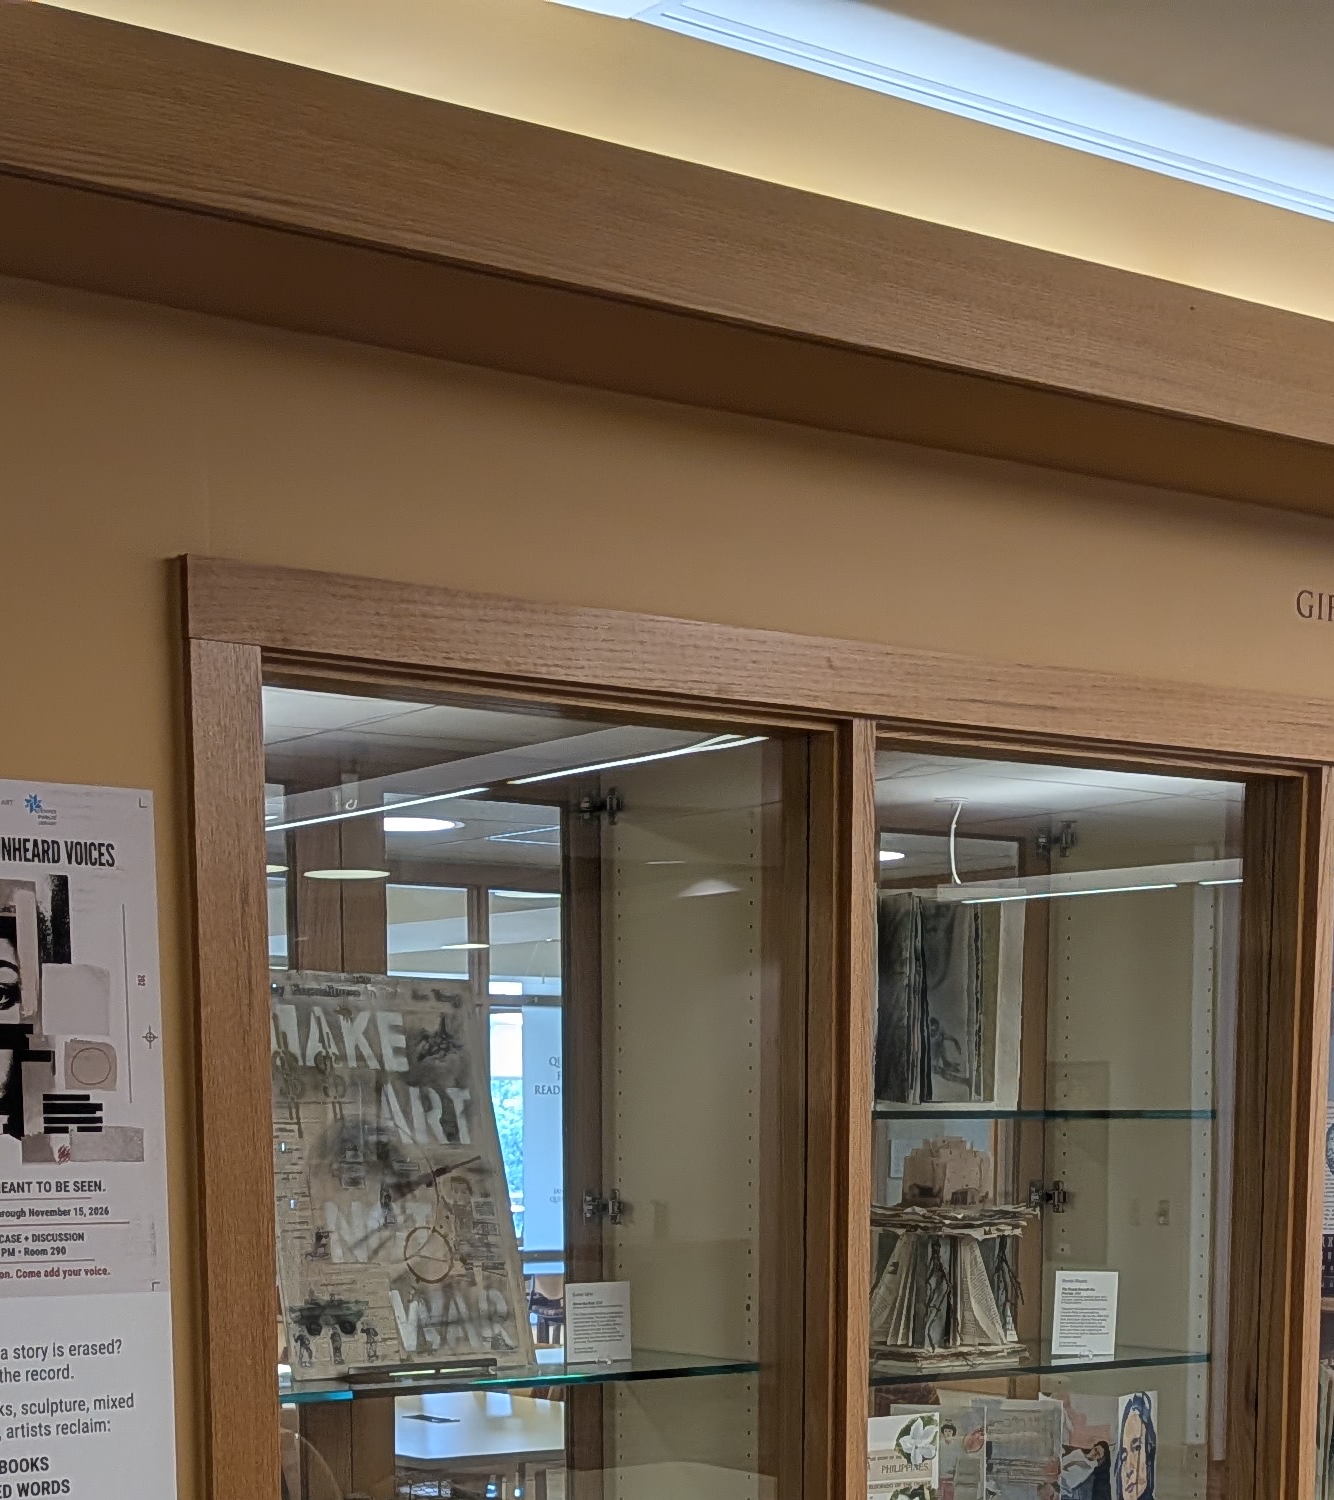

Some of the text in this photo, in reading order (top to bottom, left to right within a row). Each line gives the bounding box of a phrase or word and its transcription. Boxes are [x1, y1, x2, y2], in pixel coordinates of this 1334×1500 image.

[66, 841, 115, 867] VOICES
[379, 1082, 471, 1144] ART
[36, 1181, 51, 1193] TO
[56, 1181, 70, 1193] BE
[73, 1180, 107, 1192] SEEN.
[28, 1207, 71, 1218] November
[73, 1207, 87, 1218] 15,
[88, 1206, 110, 1216] 2026
[31, 1232, 84, 1243] DISCUSSION
[1, 1247, 16, 1257] PM
[24, 1247, 48, 1257] Room
[50, 1246, 66, 1256] 290
[16, 1268, 41, 1279] Come
[43, 1267, 60, 1278] add
[62, 1267, 81, 1280] your
[84, 1266, 110, 1277] voice.
[0, 1349, 9, 1361] a
[12, 1345, 48, 1364] story
[52, 1342, 65, 1358] is
[68, 1338, 123, 1356] erased?
[25, 1364, 75, 1382] record.
[21, 1396, 90, 1418] sculpture,
[93, 1393, 134, 1411] mixed
[6, 1421, 51, 1439] artists
[55, 1417, 112, 1437] reclaim:
[16, 1479, 70, 1498] WORDS
